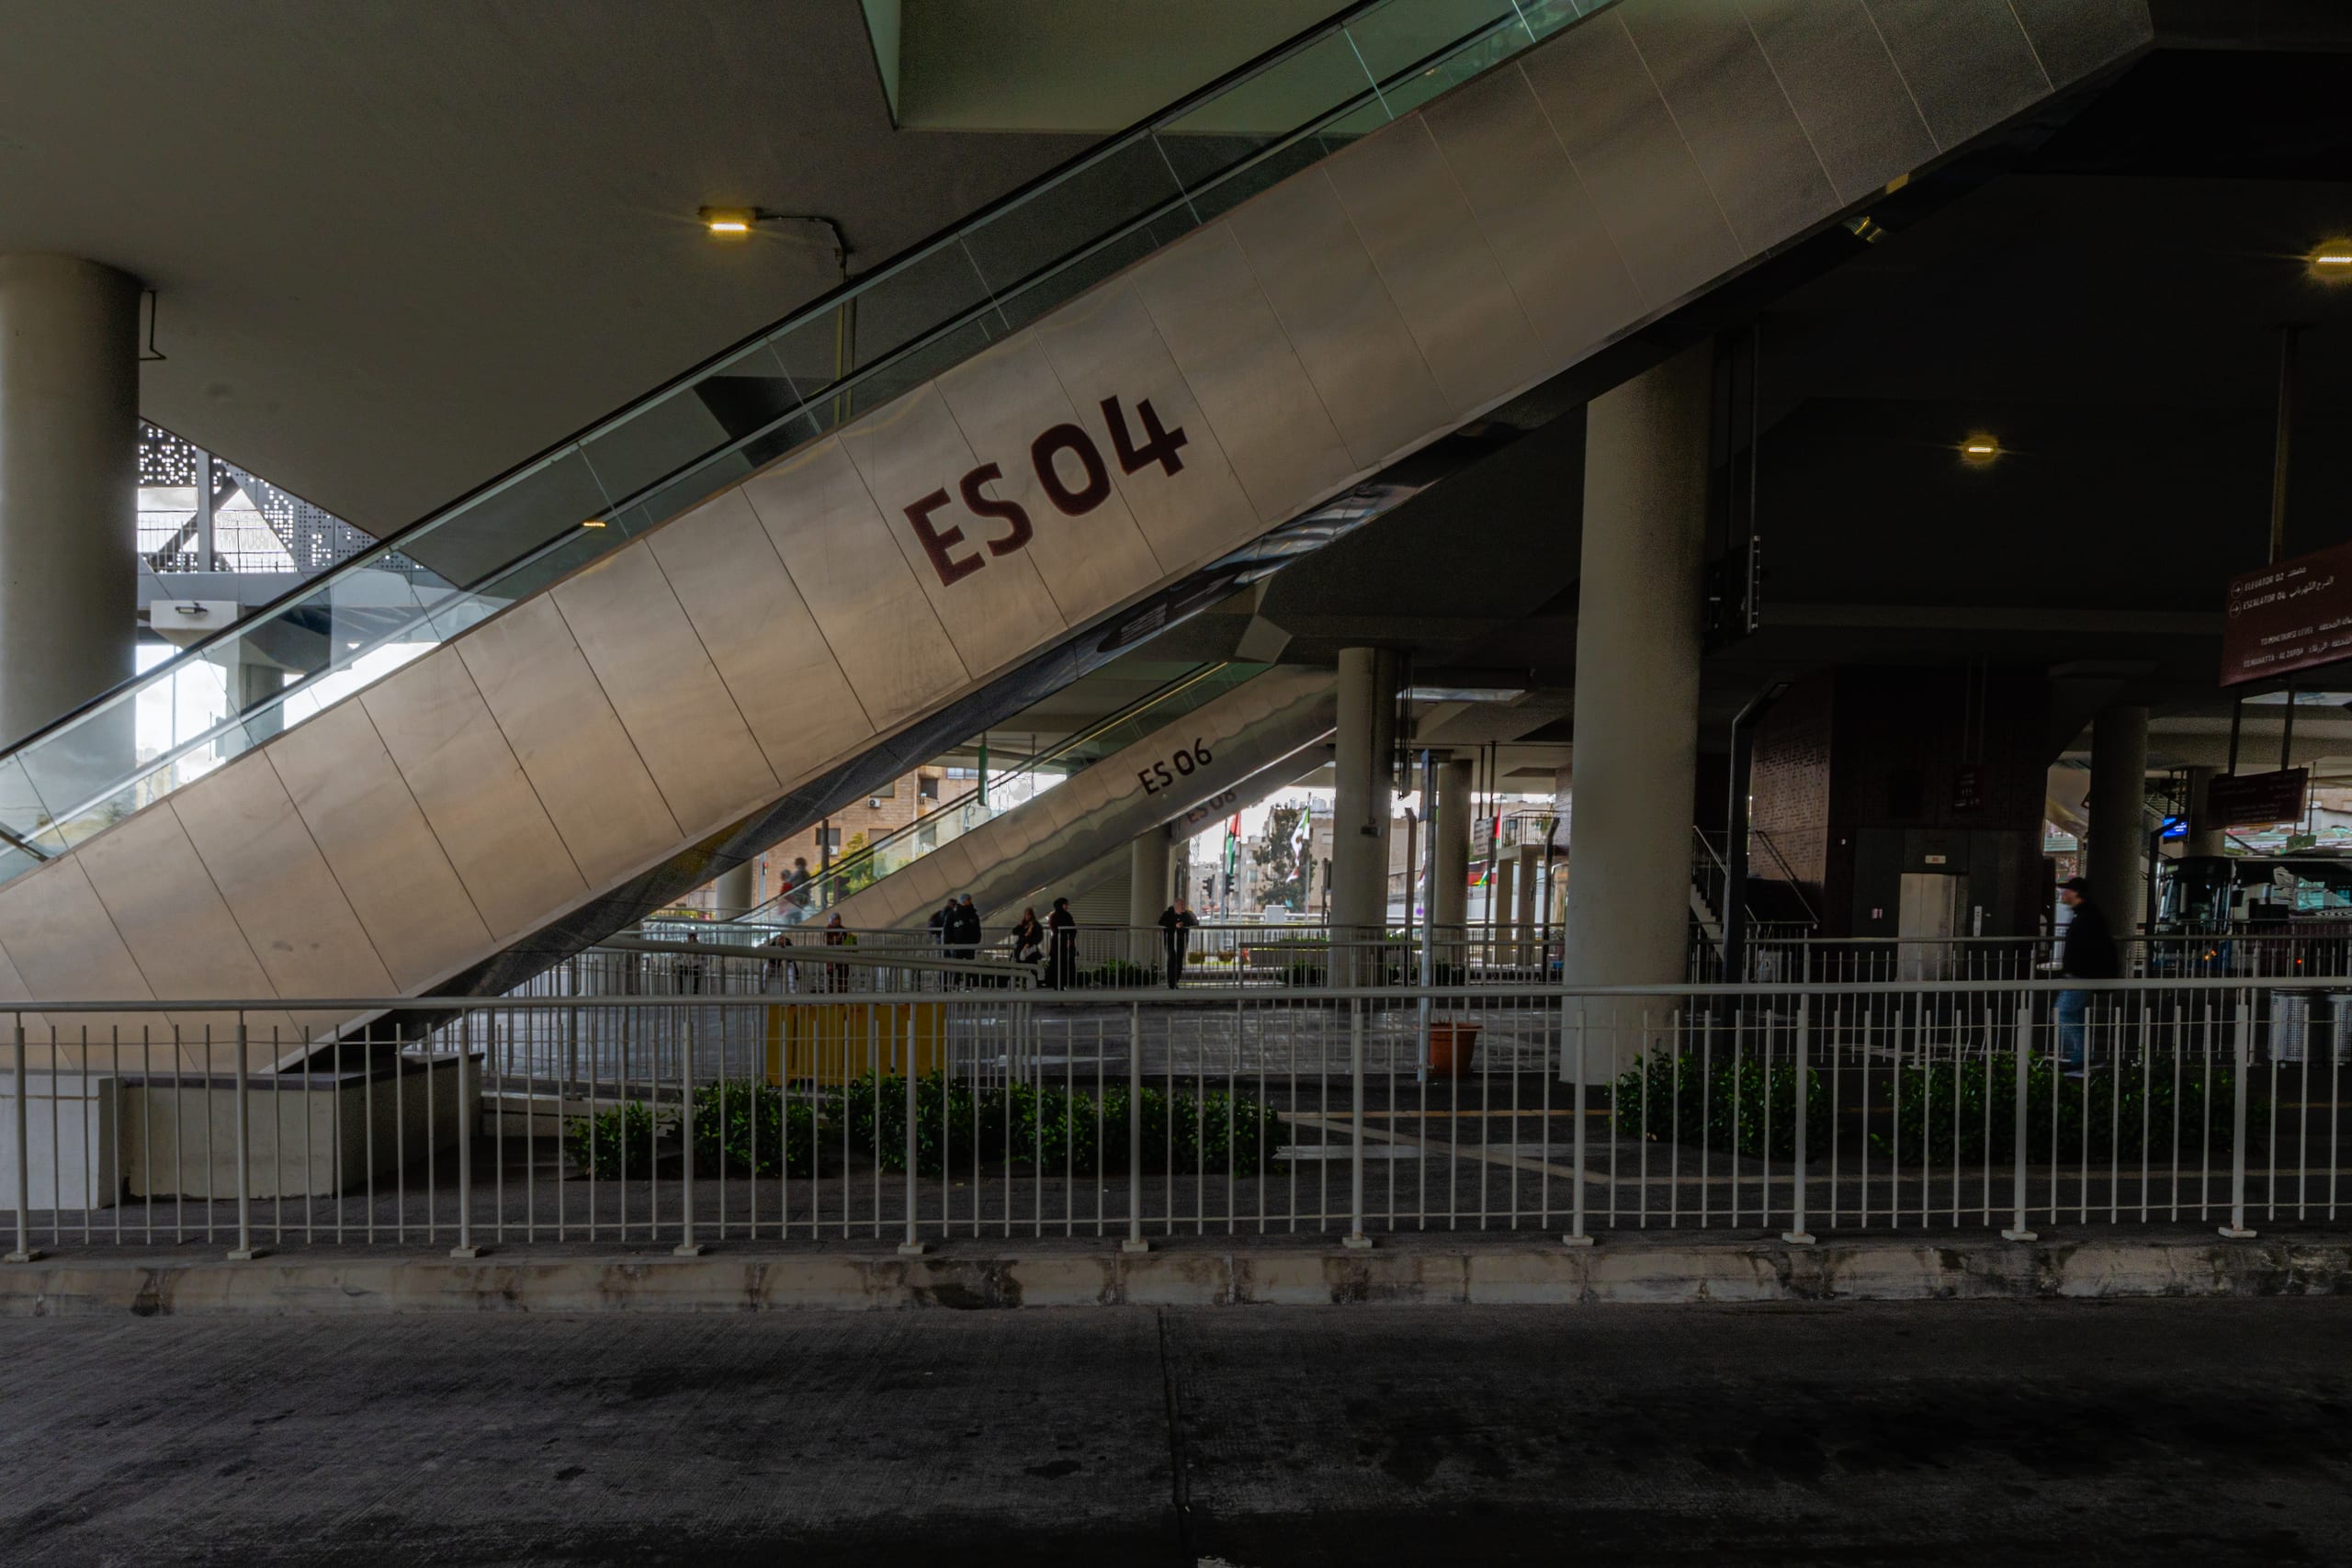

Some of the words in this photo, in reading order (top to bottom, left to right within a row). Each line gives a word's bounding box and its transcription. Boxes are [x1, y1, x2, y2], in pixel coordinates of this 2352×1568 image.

[903, 462, 1034, 587] ES
[1031, 395, 1188, 516] 04
[2243, 592, 2276, 610] ESCALATOR
[2245, 575, 2274, 592] ELEVATOR
[1137, 761, 1173, 795] ES
[1173, 738, 1212, 775] 06
